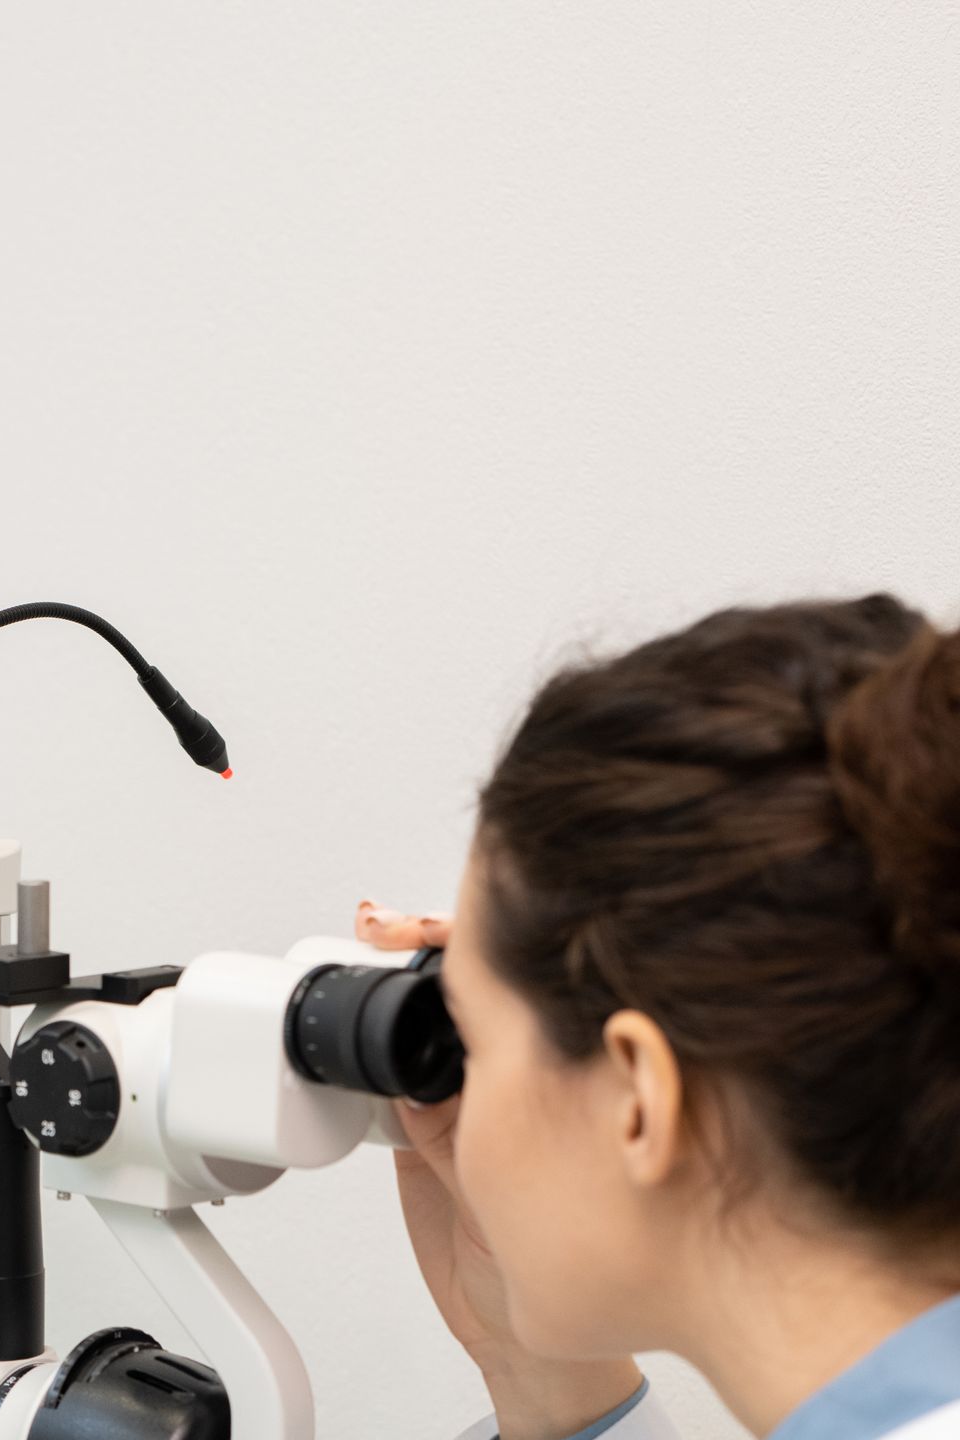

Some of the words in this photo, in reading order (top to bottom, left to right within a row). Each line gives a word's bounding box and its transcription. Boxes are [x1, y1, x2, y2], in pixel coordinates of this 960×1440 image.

[41, 1049, 55, 1065] 10
[16, 1080, 28, 1096] 16
[41, 1120, 56, 1137] 25
